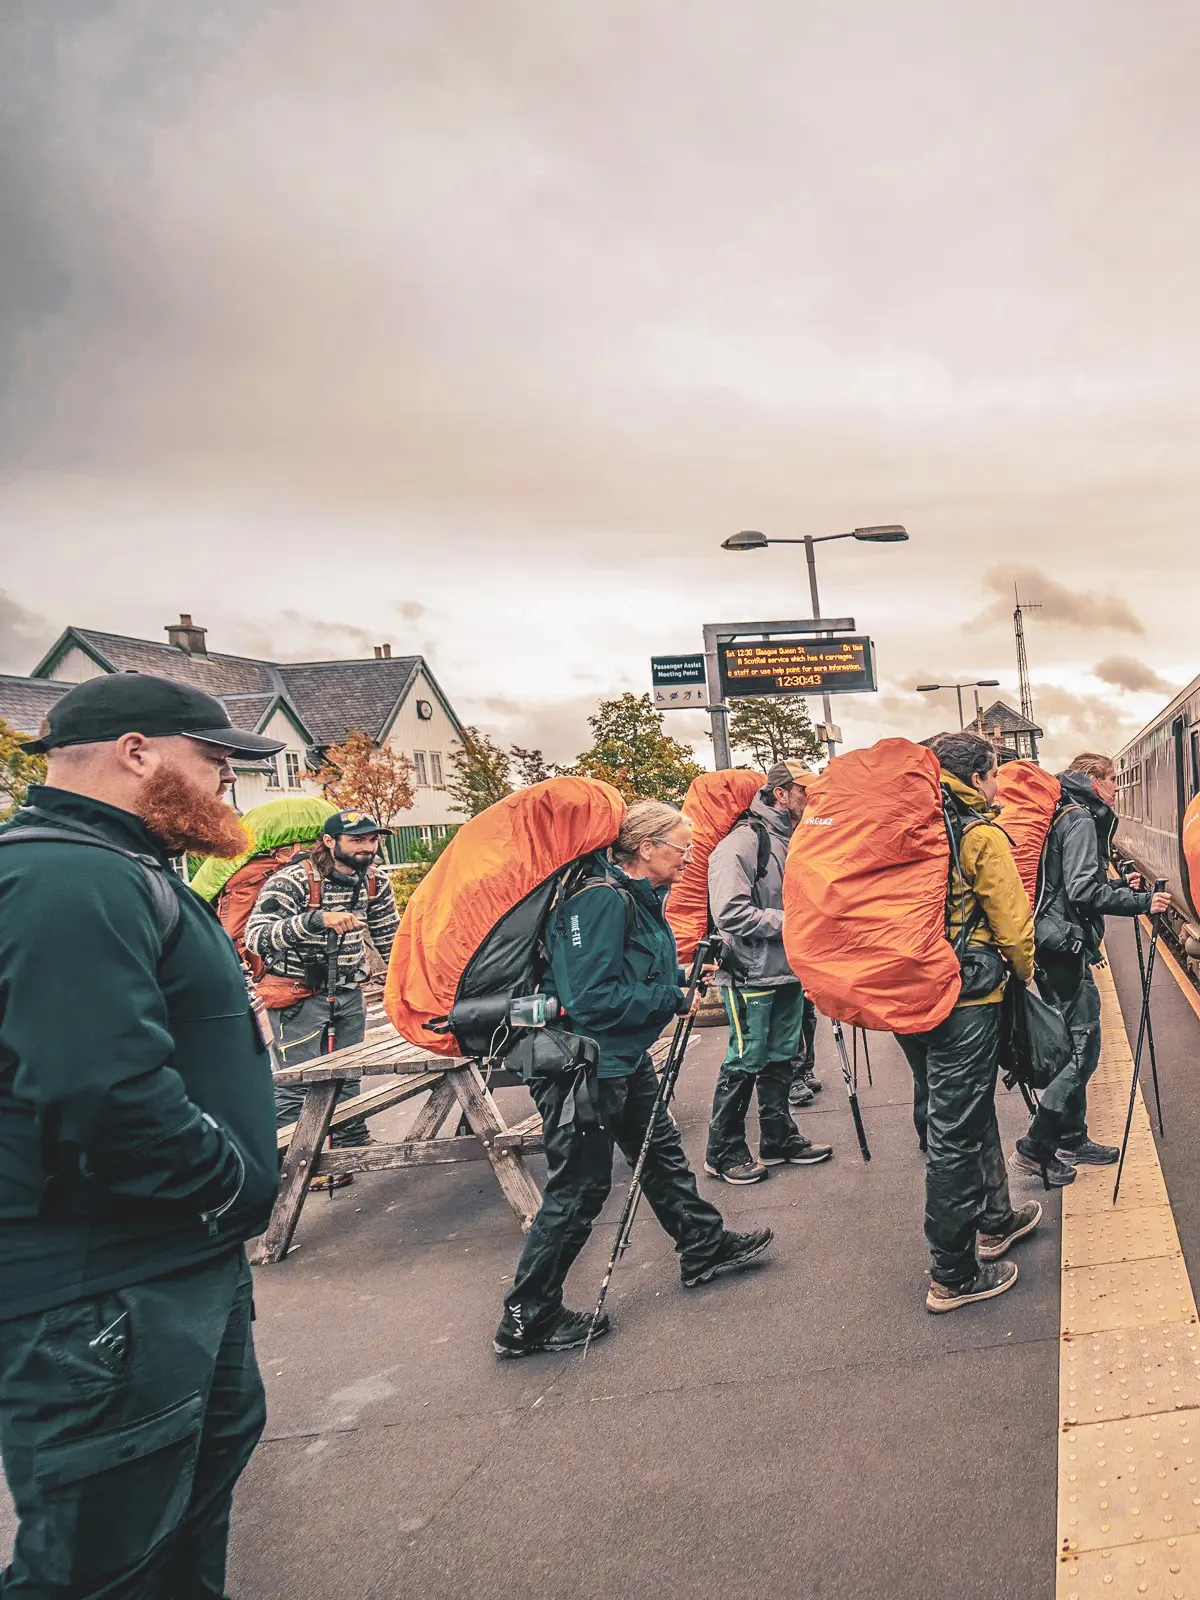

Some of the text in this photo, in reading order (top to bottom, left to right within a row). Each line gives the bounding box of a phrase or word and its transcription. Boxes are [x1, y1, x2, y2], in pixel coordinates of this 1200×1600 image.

[737, 649, 752, 657] 12:30
[756, 648, 777, 656] Glasgow
[797, 646, 805, 654] St
[734, 668, 749, 676] staff
[772, 667, 784, 675] help
[786, 667, 800, 675] point
[778, 675, 821, 687] 12:30:43
